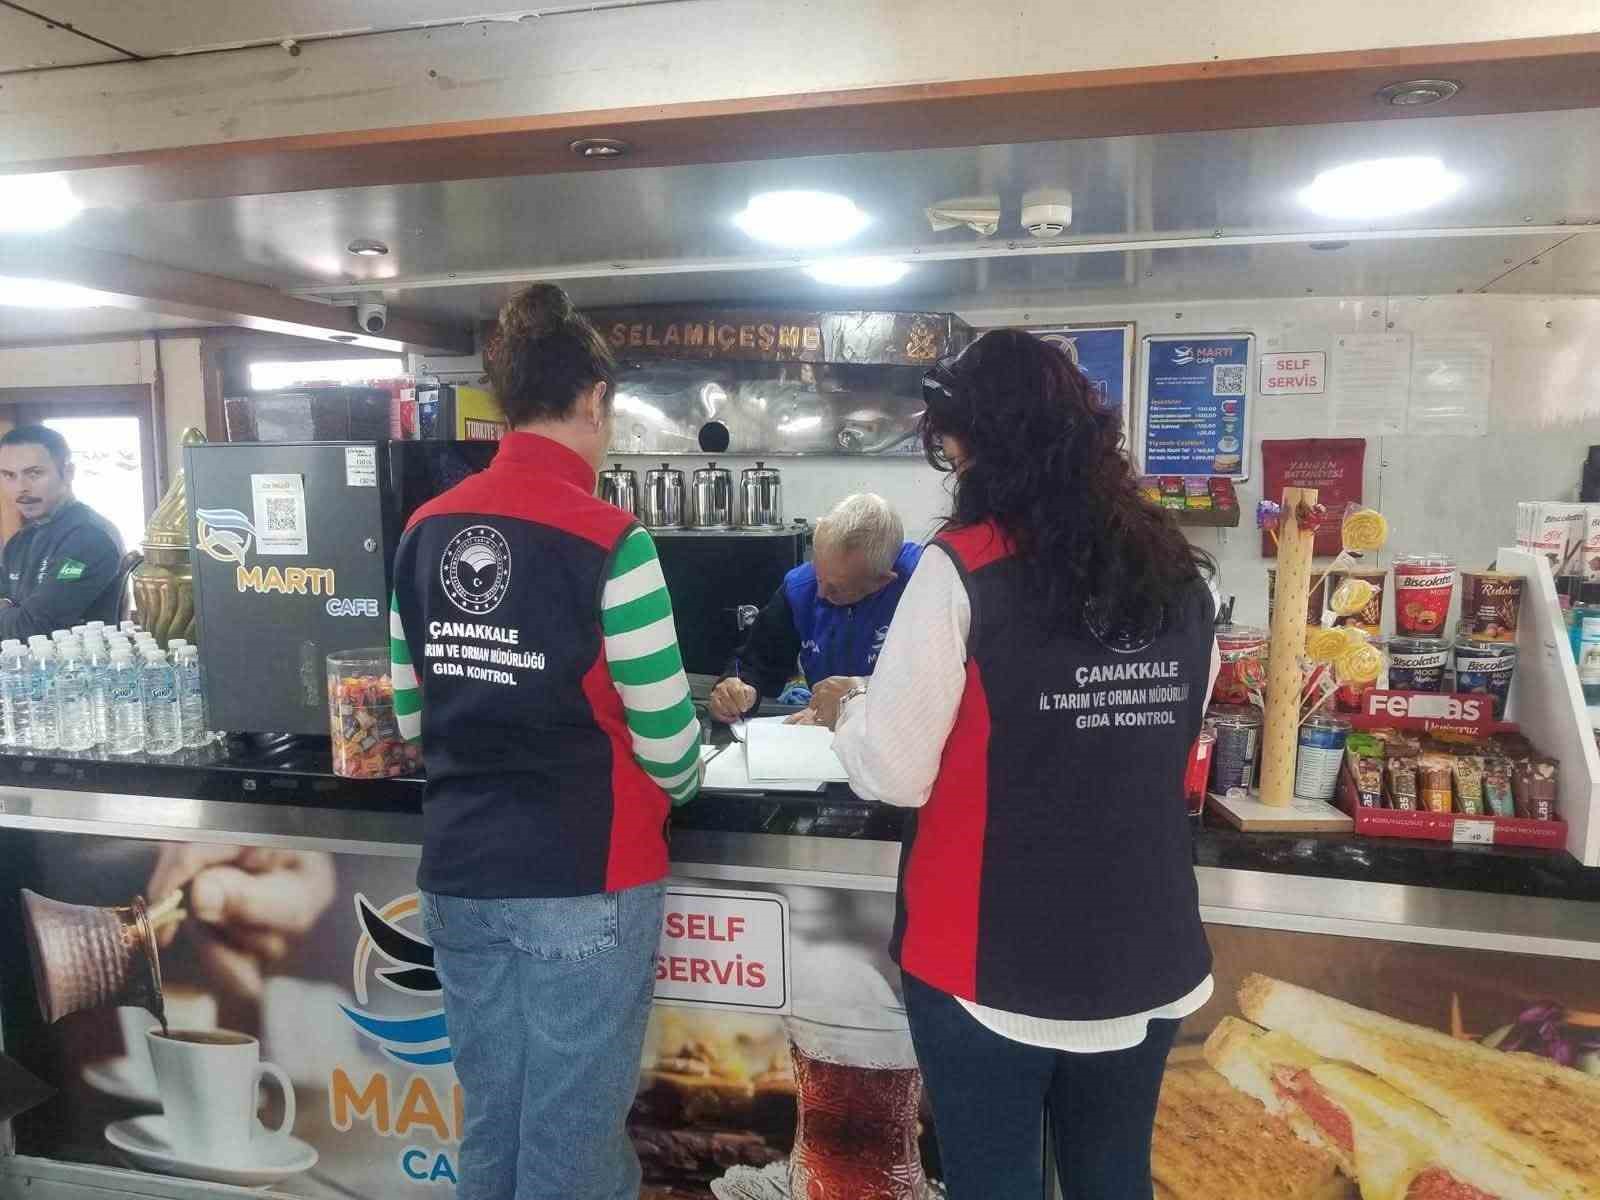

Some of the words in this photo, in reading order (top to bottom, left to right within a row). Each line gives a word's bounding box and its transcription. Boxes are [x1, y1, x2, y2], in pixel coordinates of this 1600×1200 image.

[1276, 359, 1310, 370] SELF
[1267, 373, 1318, 388] SERVİS
[236, 565, 336, 596] MARTI
[326, 598, 379, 617] CAFE
[429, 621, 519, 645] ÇANAKKALE
[446, 644, 459, 659] VE
[461, 645, 490, 661] ORMAN
[490, 647, 546, 670] MÜDÜRLÜĞÜ
[433, 662, 465, 677] GIDA
[467, 666, 518, 686] KONTROL
[1075, 661, 1179, 688] ÇANAKKALE
[1040, 692, 1050, 710] İL
[1053, 693, 1090, 710] TARIM
[1093, 691, 1106, 707] VE
[1108, 688, 1147, 706] ORMAN
[1076, 713, 1110, 729] GIDA
[1114, 711, 1176, 727] KONTROL
[666, 912, 746, 942] SELF
[655, 953, 766, 989] SERVİS
[329, 1067, 464, 1142] MA
